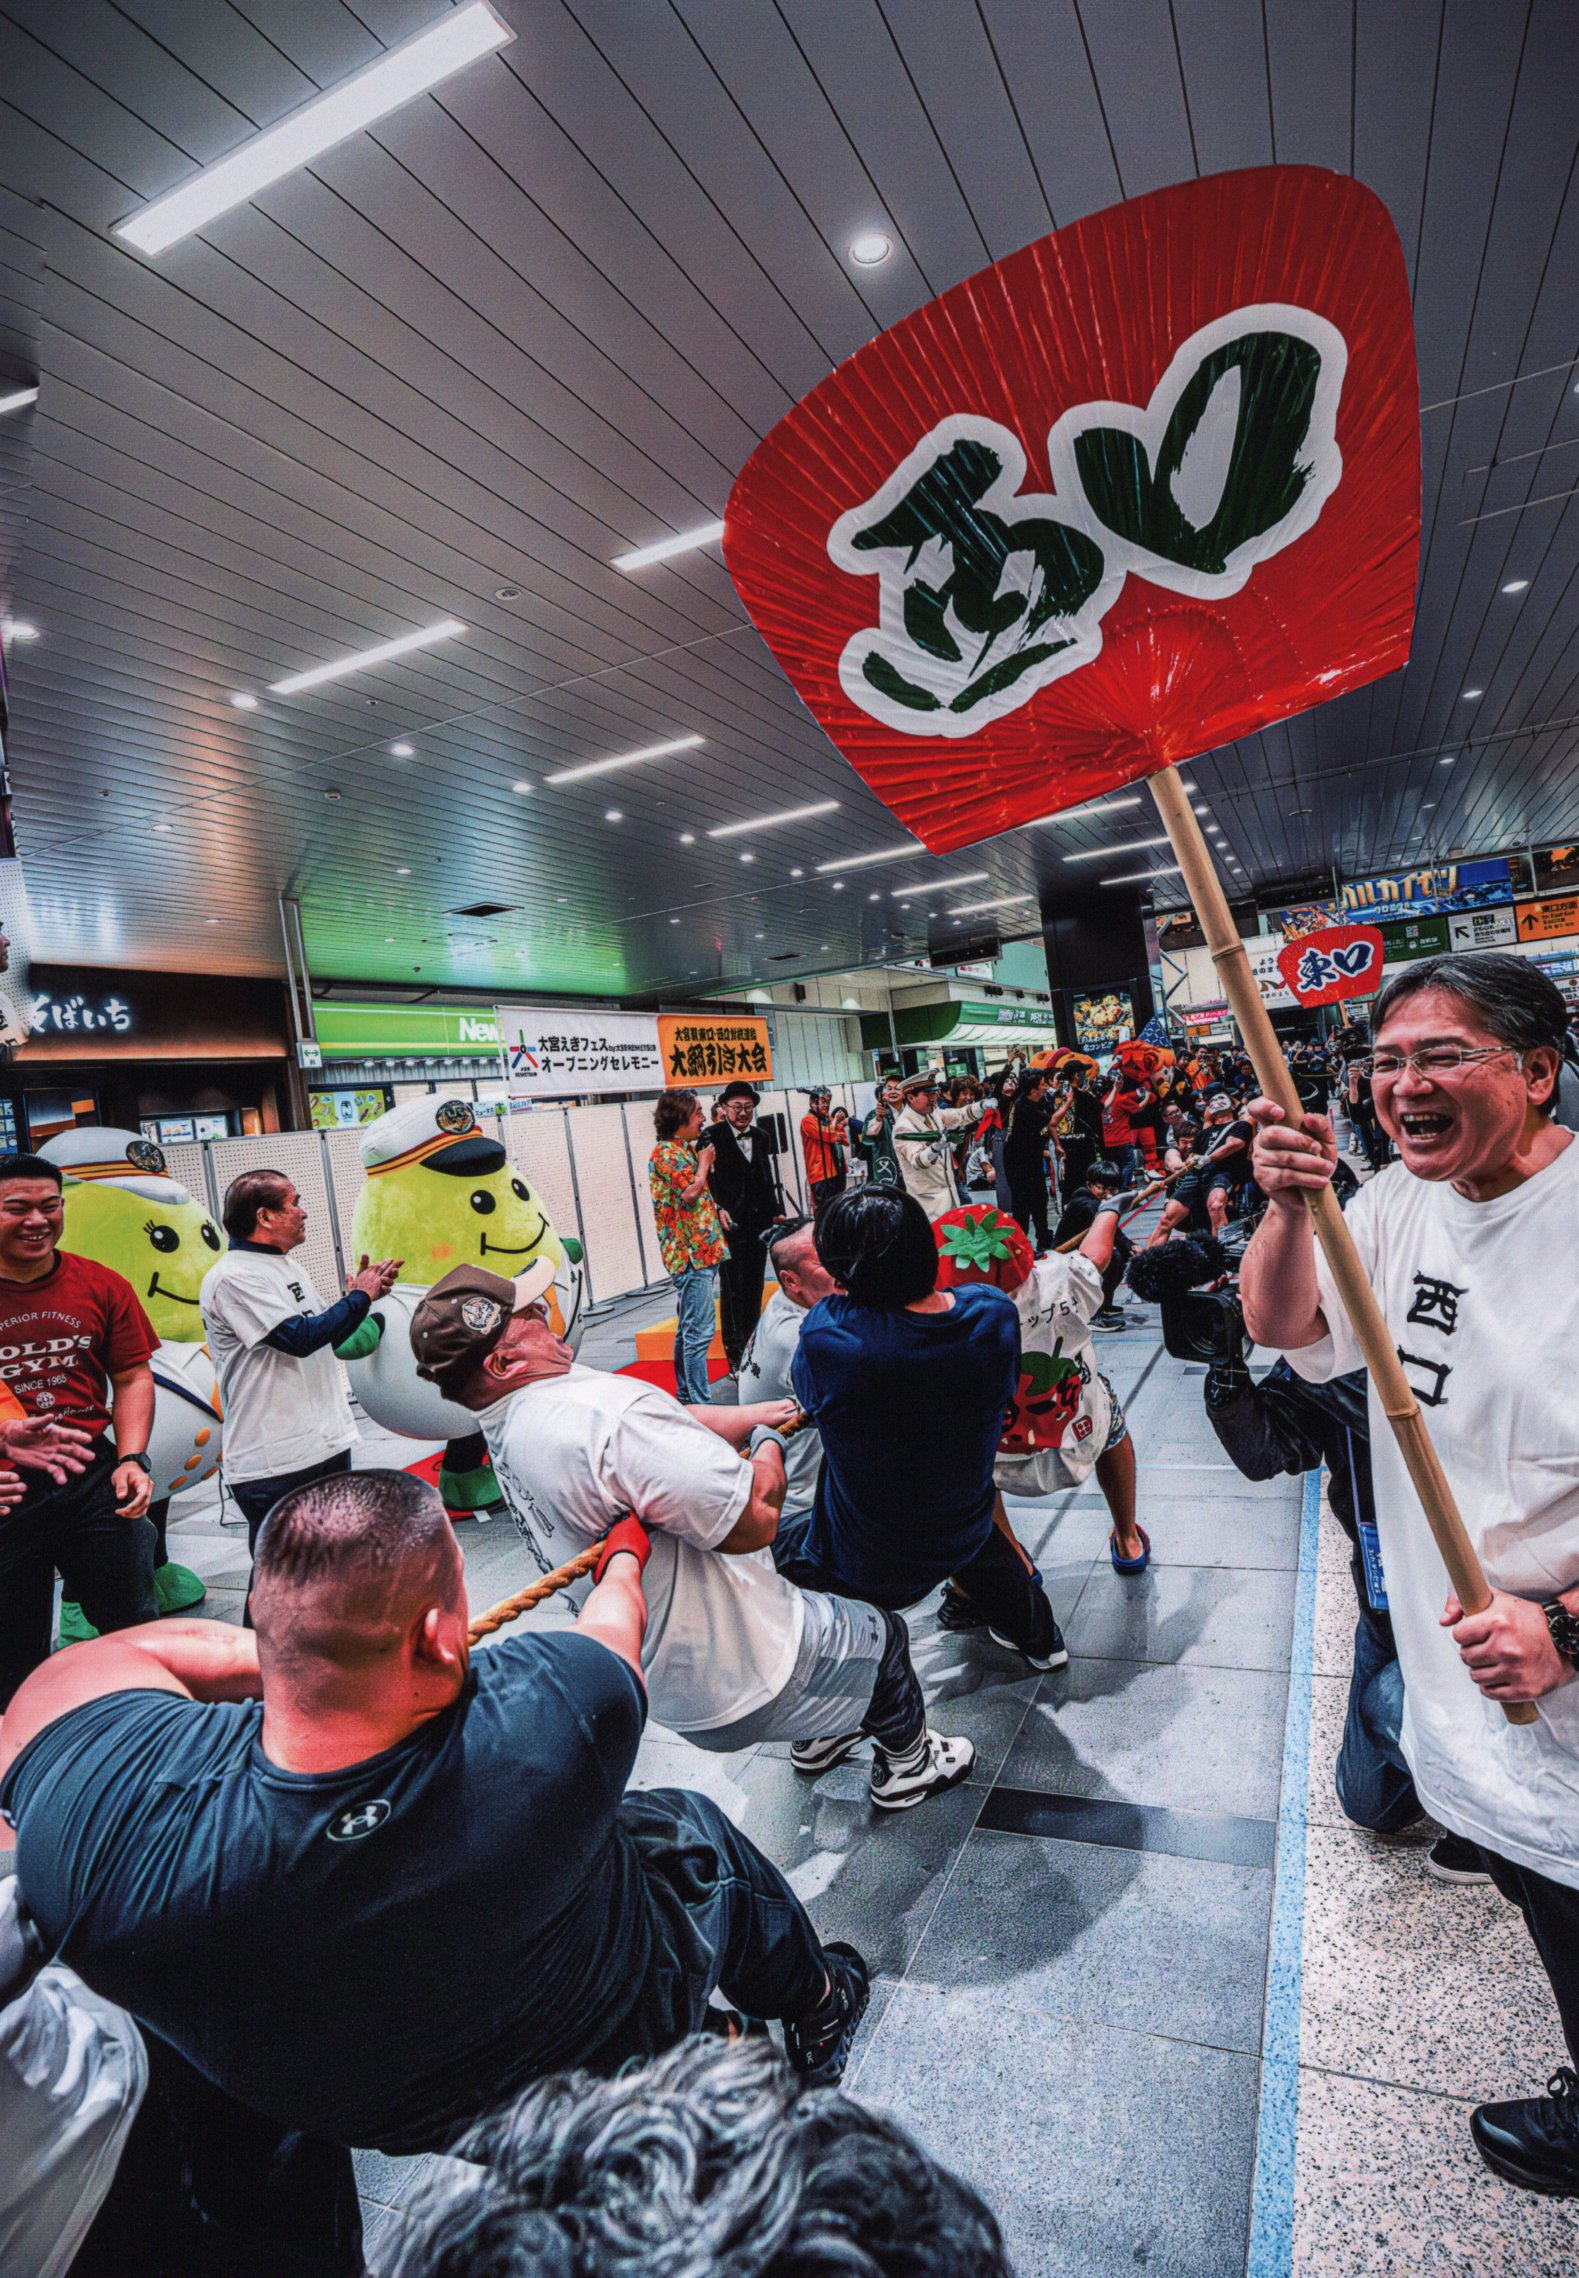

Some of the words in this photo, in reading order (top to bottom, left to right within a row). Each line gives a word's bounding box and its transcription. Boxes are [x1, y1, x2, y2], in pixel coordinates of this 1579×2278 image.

[1301, 944, 1371, 989] 東口
[538, 1036, 609, 1053] 大宮えきフェス
[541, 1056, 659, 1073] オープニングセレモニー
[669, 1042, 767, 1077] 大綱引き大会
[42, 1311, 82, 1329] FITNESS
[14, 1379, 44, 1394] SINCE
[47, 1374, 67, 1386] 1965
